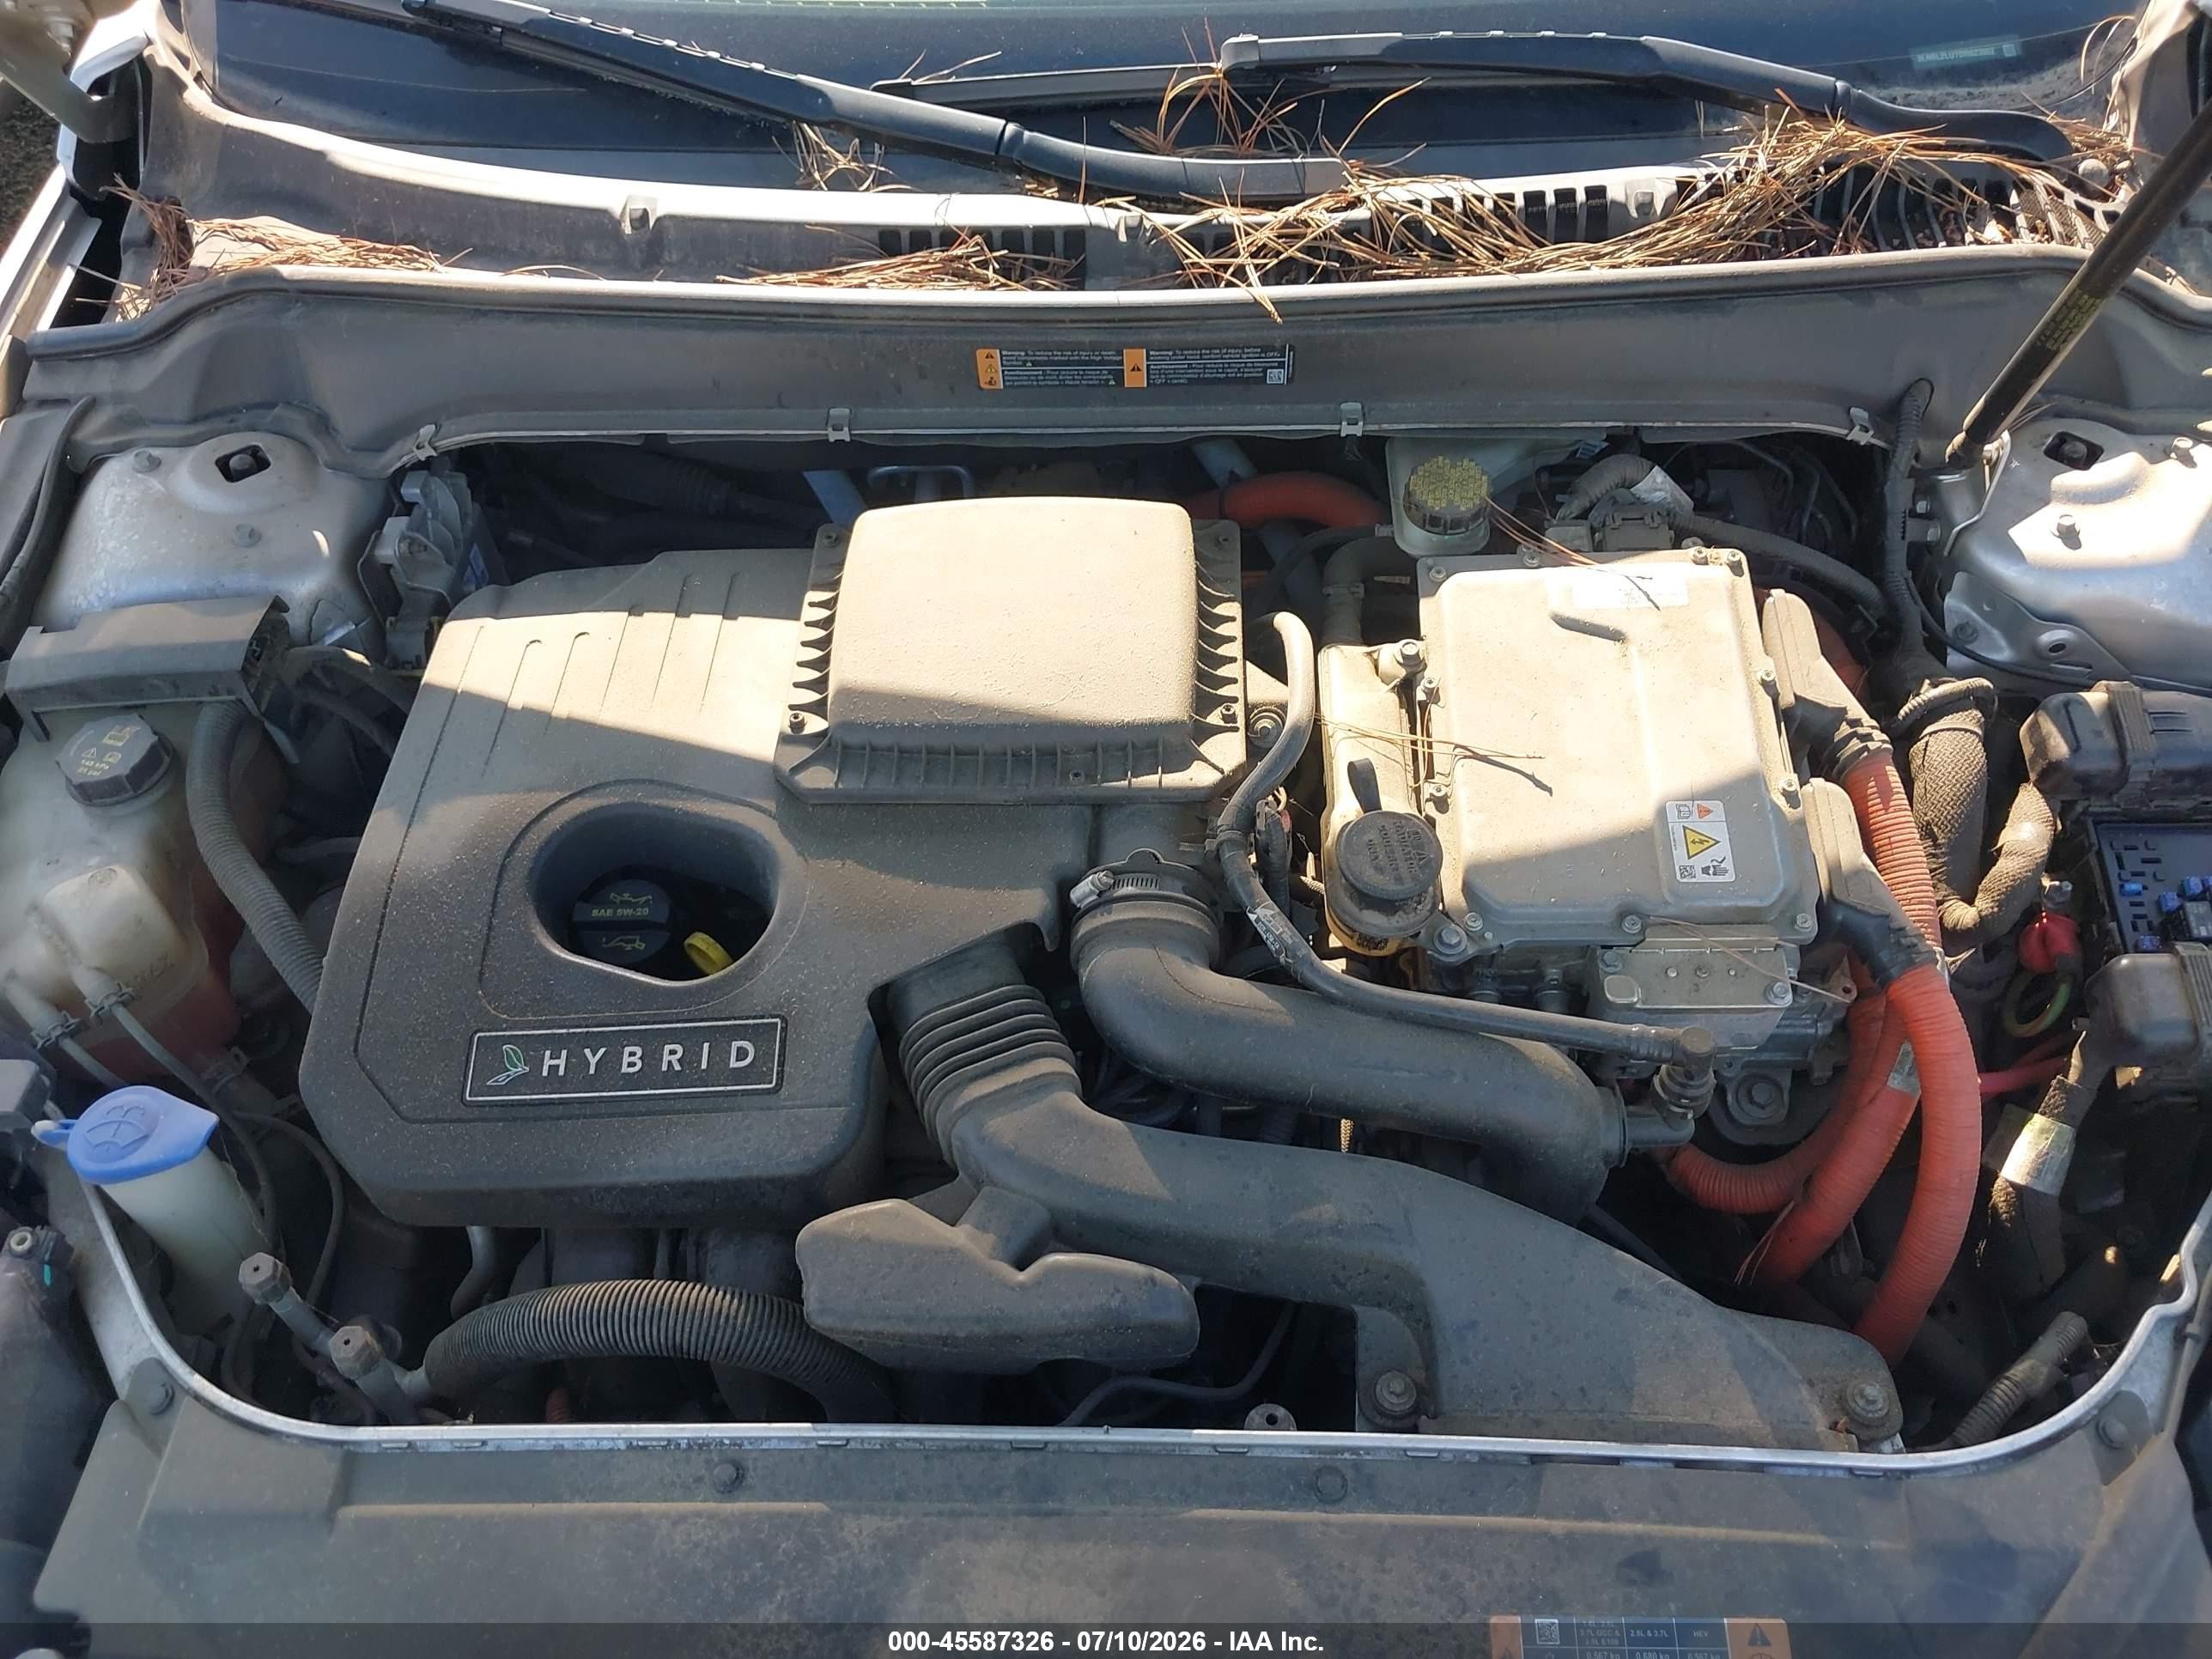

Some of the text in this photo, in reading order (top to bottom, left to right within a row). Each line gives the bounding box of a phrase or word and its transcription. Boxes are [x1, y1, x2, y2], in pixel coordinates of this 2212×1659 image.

[591, 907, 649, 917] SAE 5W-20
[542, 1040, 756, 1078] HYBRID
